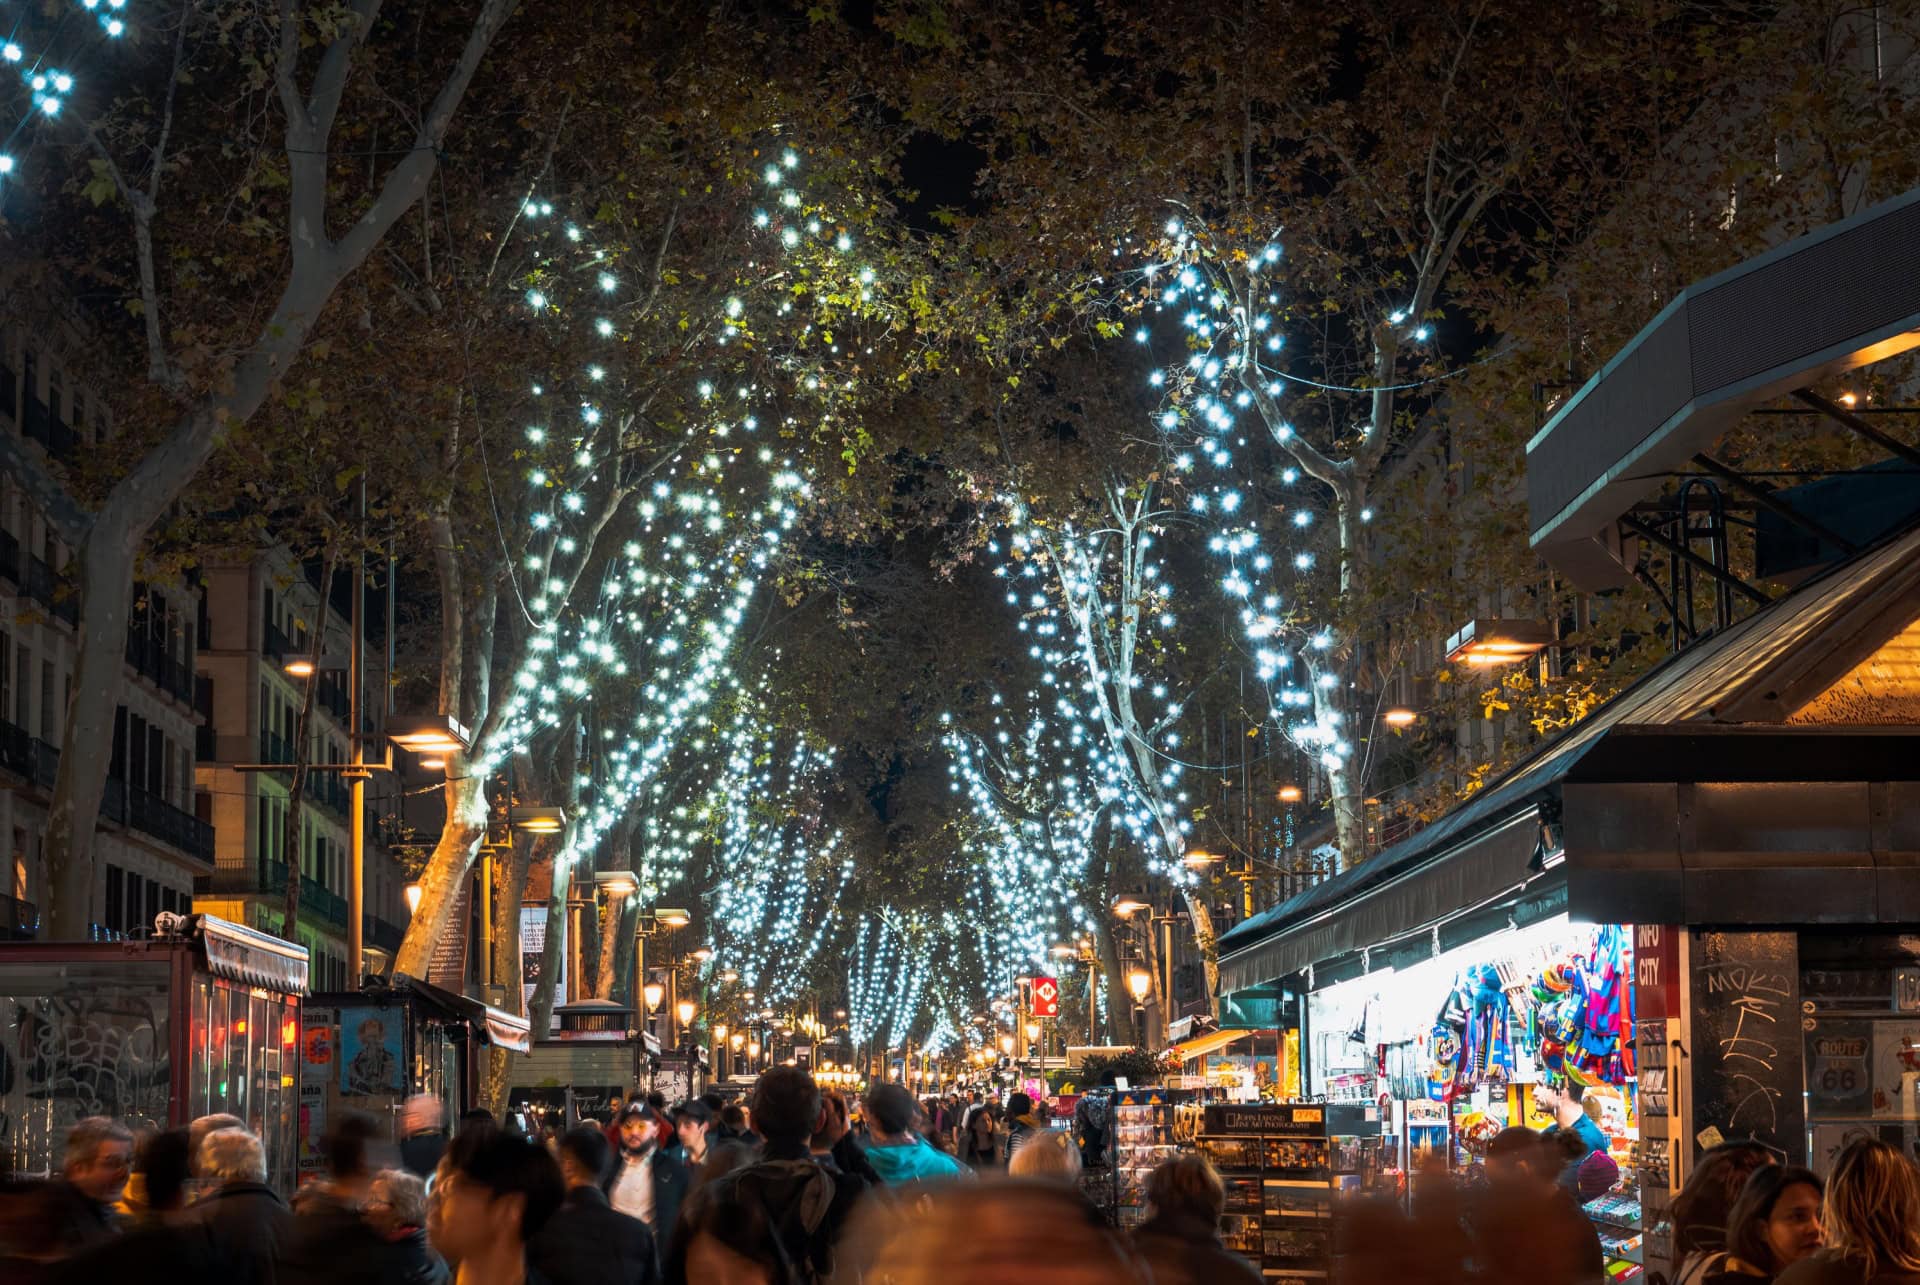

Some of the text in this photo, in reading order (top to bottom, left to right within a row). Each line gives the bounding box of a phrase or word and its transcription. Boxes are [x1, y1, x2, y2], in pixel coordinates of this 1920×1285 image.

[1638, 924, 1659, 947] INFO
[1639, 957, 1660, 987] CITY
[1821, 1041, 1861, 1056] ROUTE
[1822, 1071, 1856, 1090] 66
